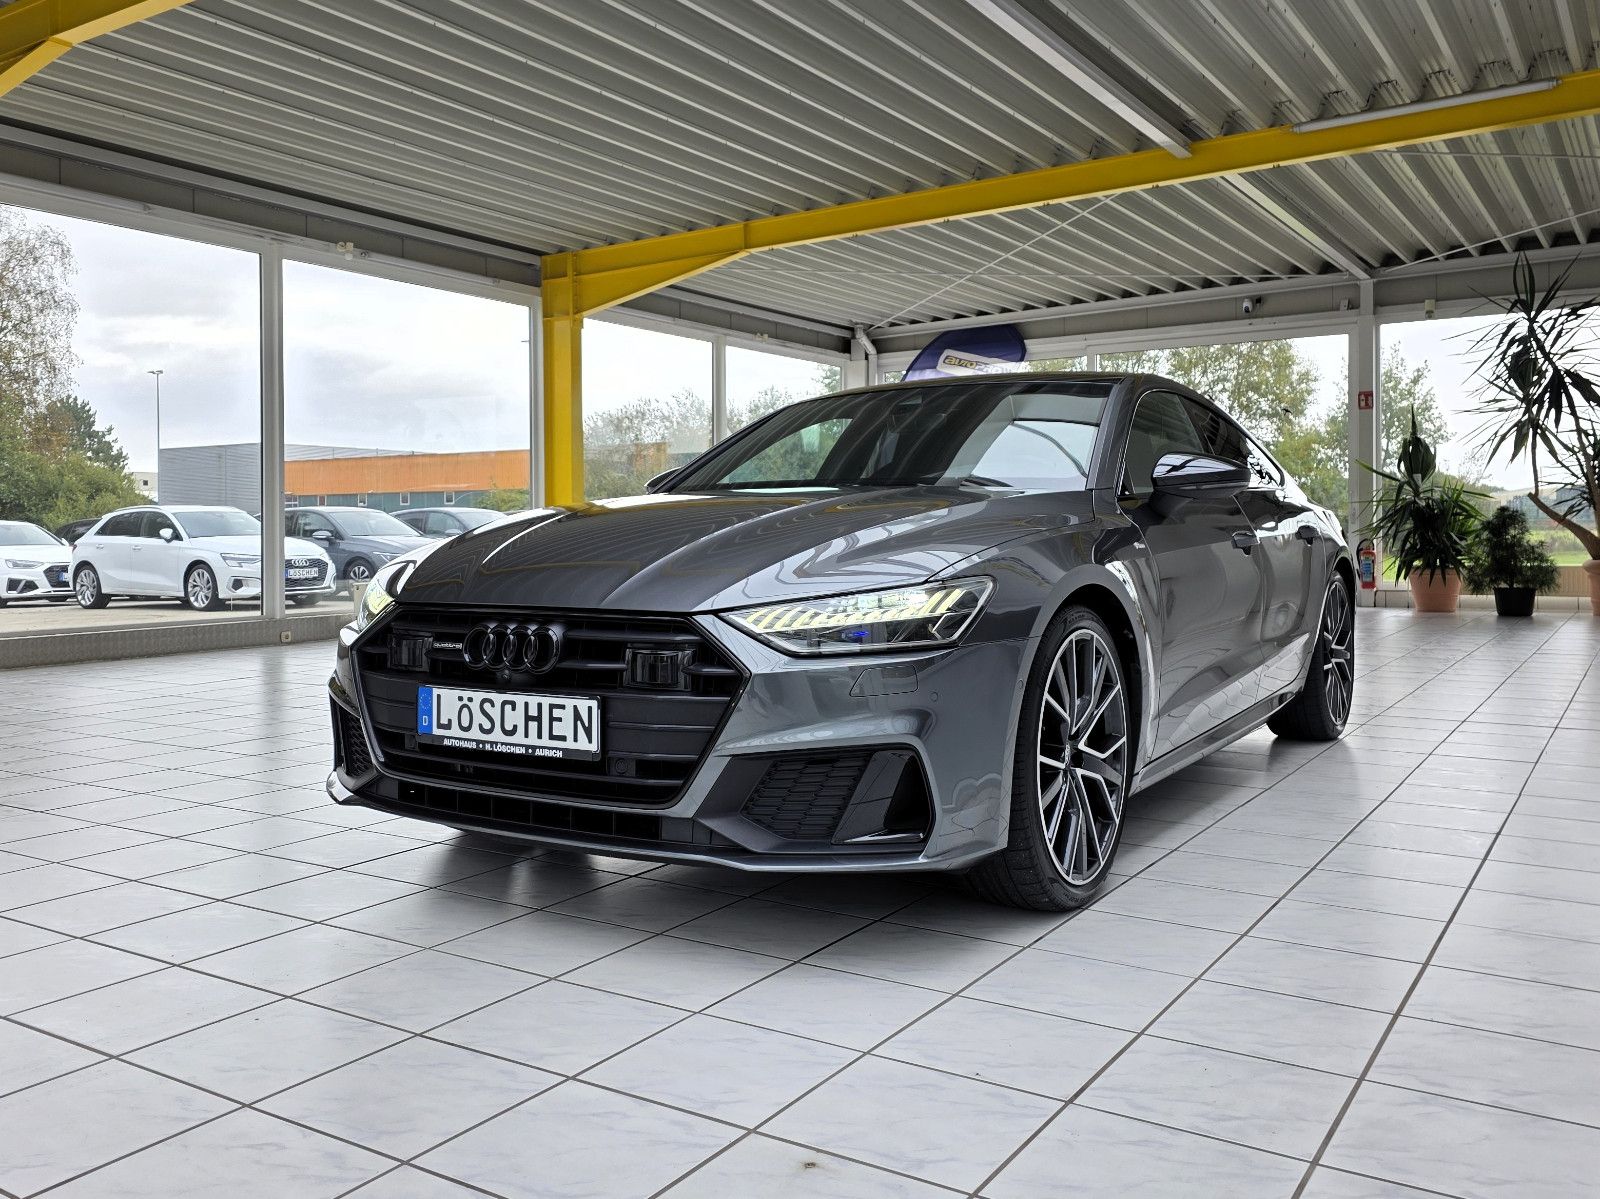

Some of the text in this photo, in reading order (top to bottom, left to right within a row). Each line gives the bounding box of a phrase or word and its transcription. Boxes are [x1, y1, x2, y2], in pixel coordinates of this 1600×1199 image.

[436, 693, 593, 744] LÖSCHEN
[443, 738, 563, 758] AUTOHAUS H. LÖSCHEN AURICH
